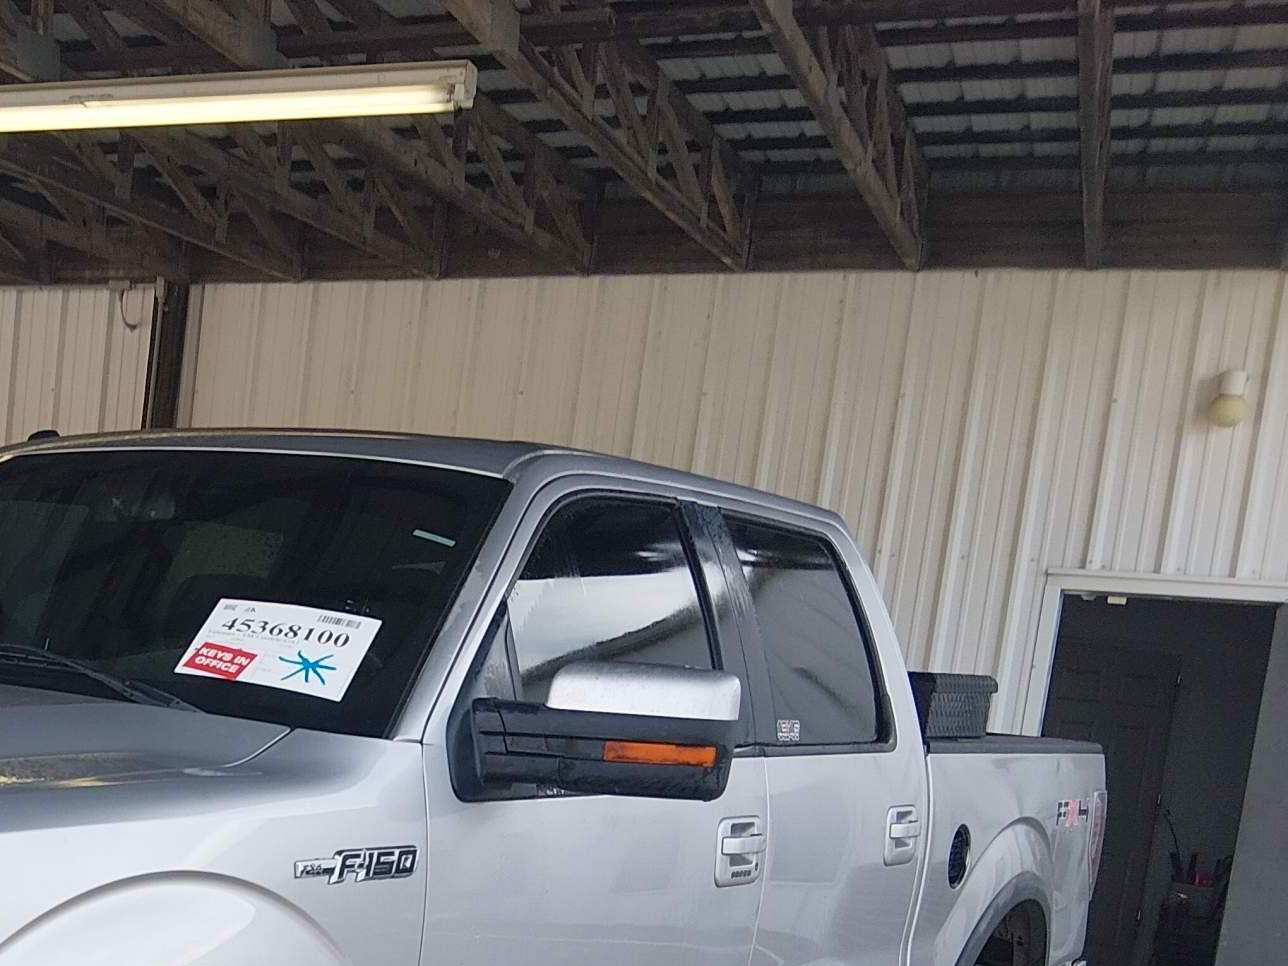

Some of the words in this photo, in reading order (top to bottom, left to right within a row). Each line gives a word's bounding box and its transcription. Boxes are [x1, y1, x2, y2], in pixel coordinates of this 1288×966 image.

[222, 617, 351, 648] 45368100
[194, 655, 240, 674] OFFICE
[199, 647, 234, 662] KEYS
[233, 655, 251, 666] IN
[1056, 800, 1089, 828] FX4
